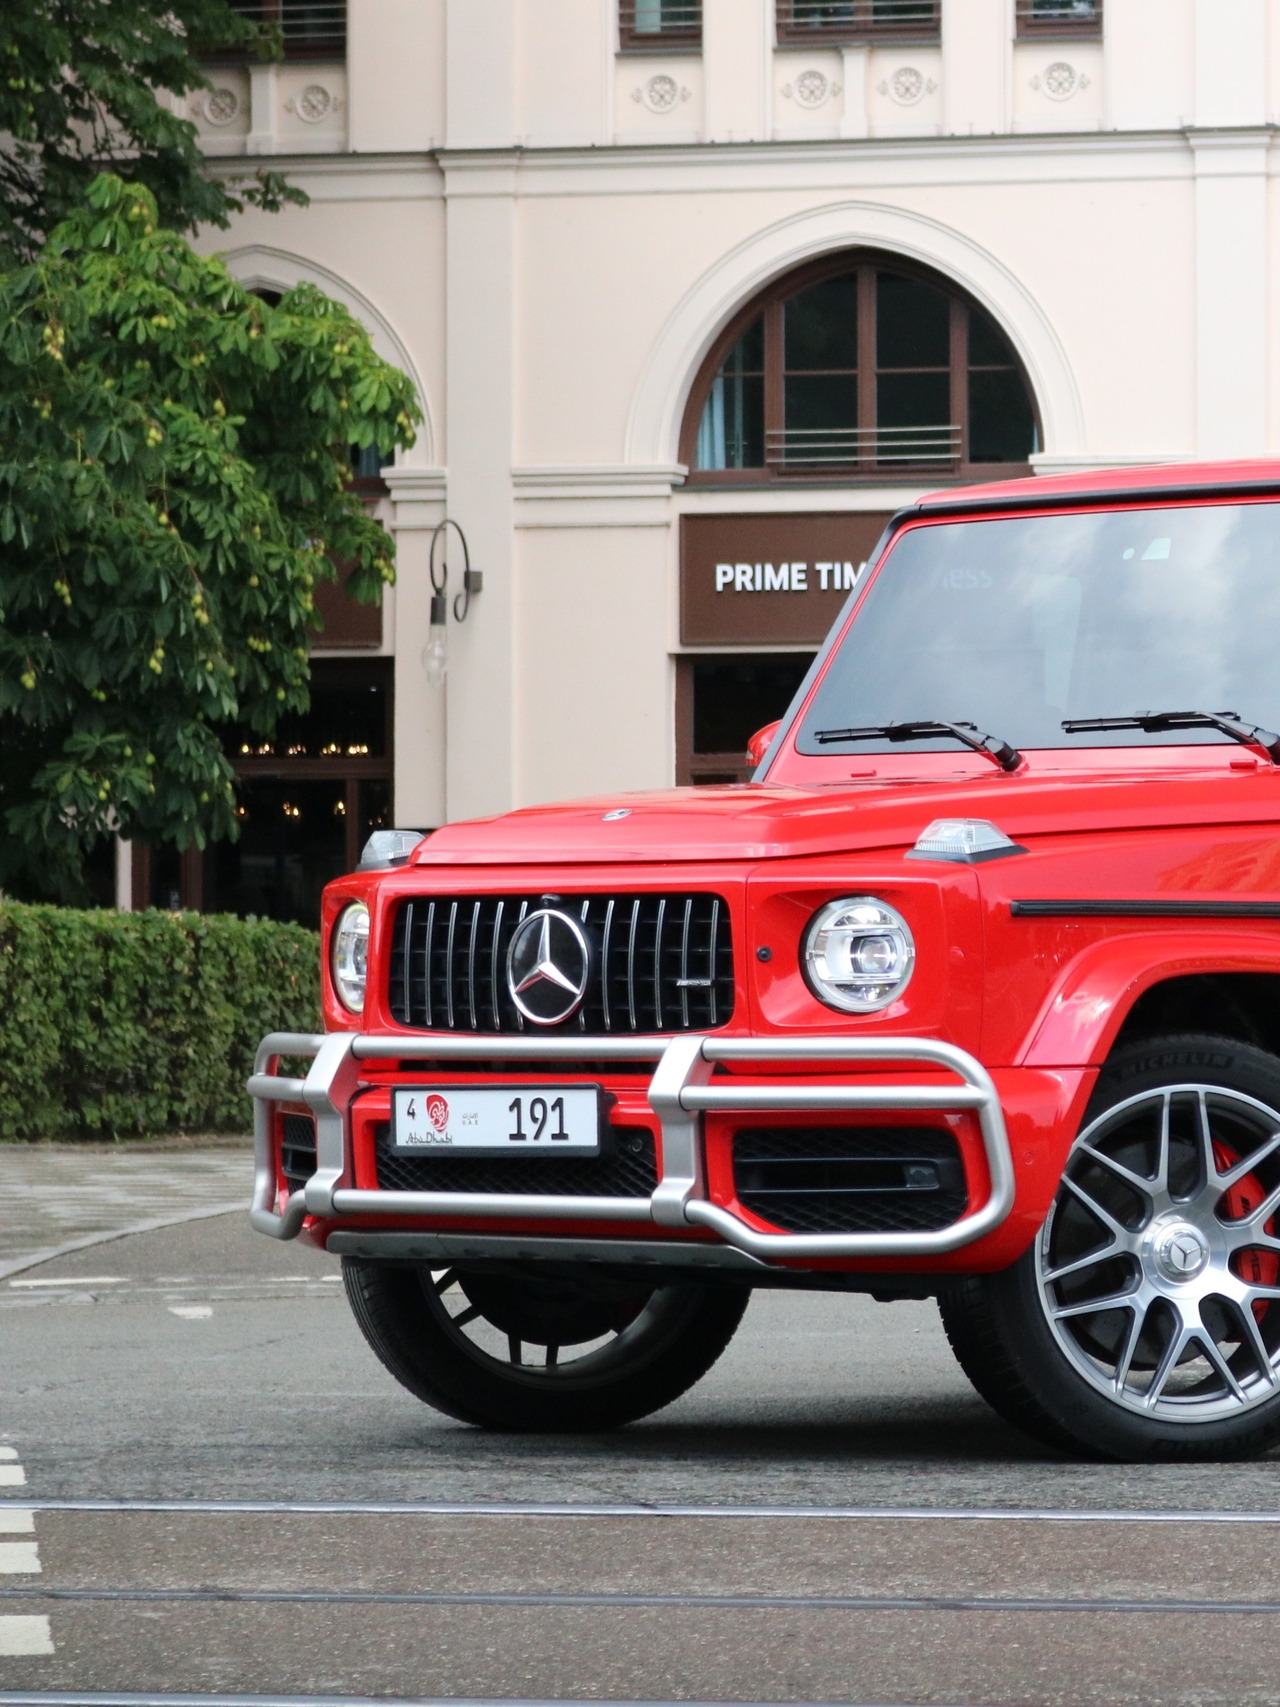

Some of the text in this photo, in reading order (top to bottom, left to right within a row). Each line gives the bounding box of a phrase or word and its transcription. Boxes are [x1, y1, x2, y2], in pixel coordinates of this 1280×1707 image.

[716, 563, 808, 591] PRIME
[1121, 1052, 1228, 1077] MICHELIN
[407, 1098, 417, 1121] 4
[508, 1097, 570, 1141] 191
